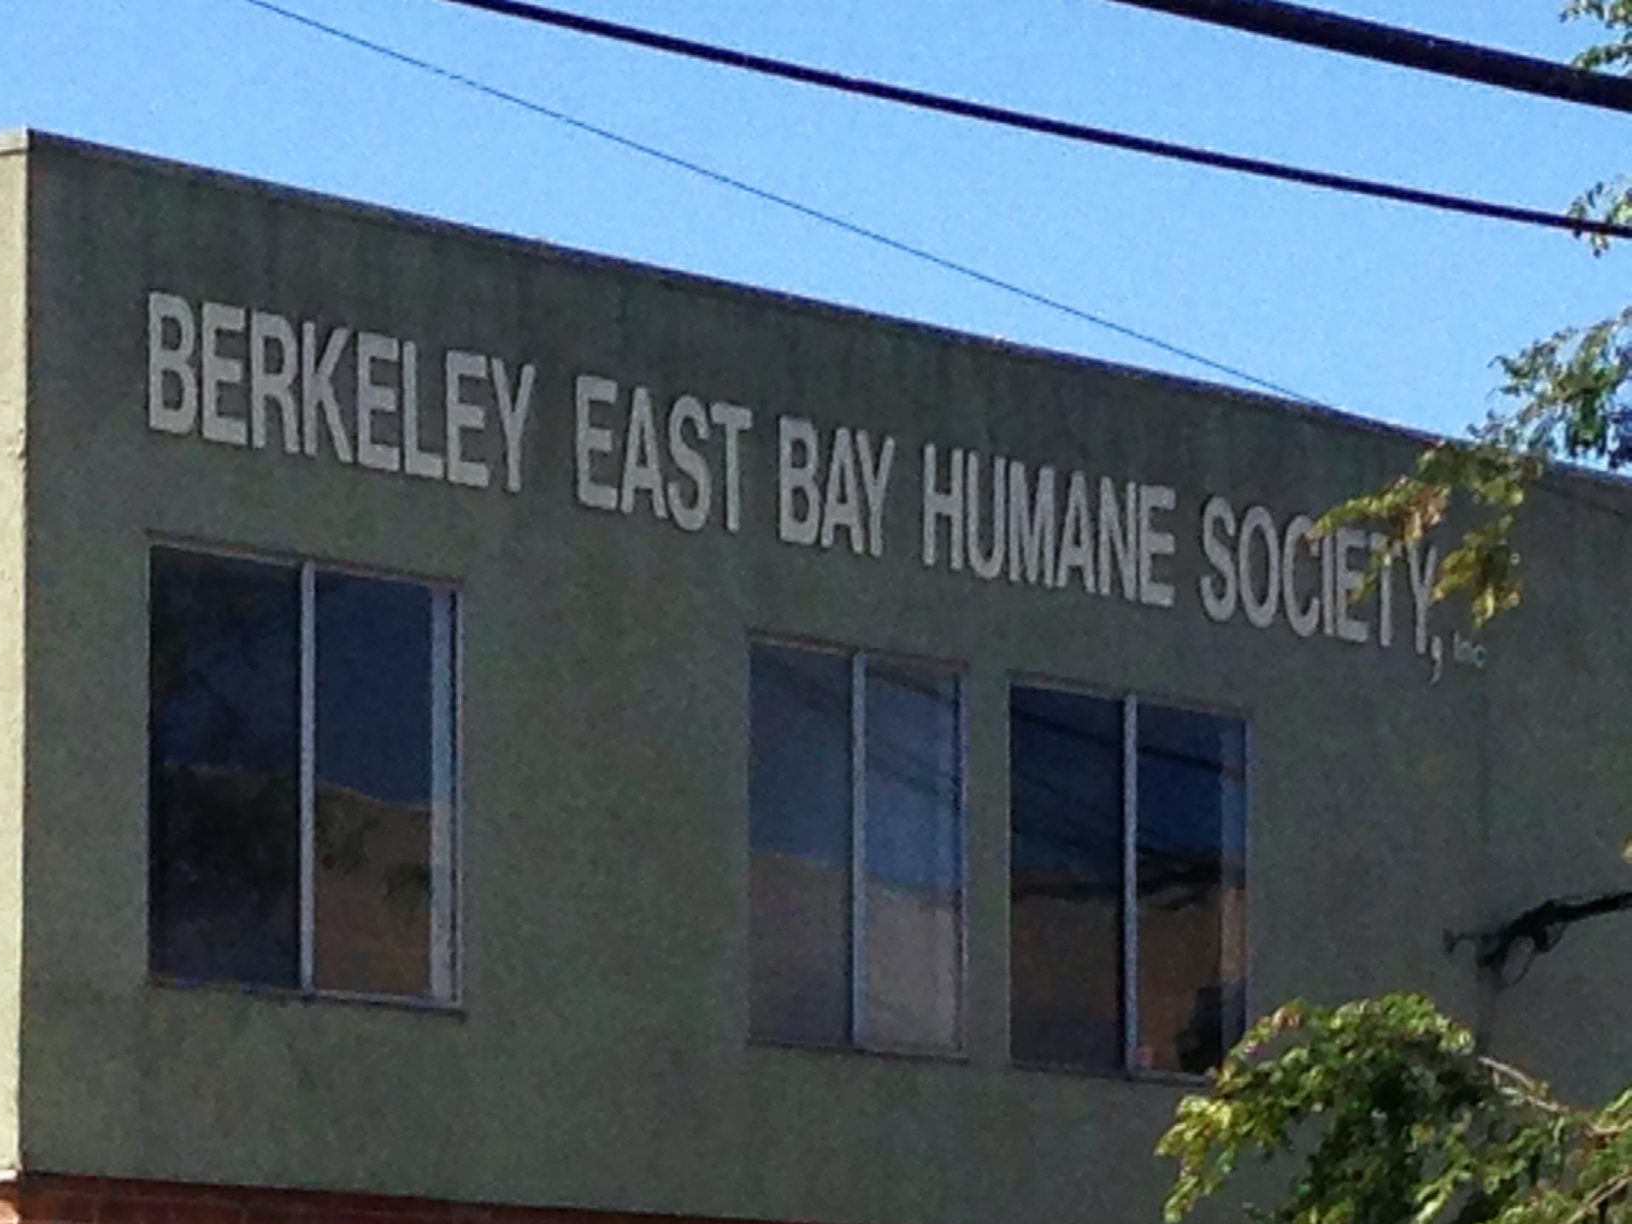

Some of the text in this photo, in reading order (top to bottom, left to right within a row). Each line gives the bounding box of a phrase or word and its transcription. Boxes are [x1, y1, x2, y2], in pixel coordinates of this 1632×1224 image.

[147, 290, 536, 493] BERKELEY
[575, 374, 753, 532] EAST
[778, 414, 896, 559] BAY
[922, 442, 1176, 608] HUMANE
